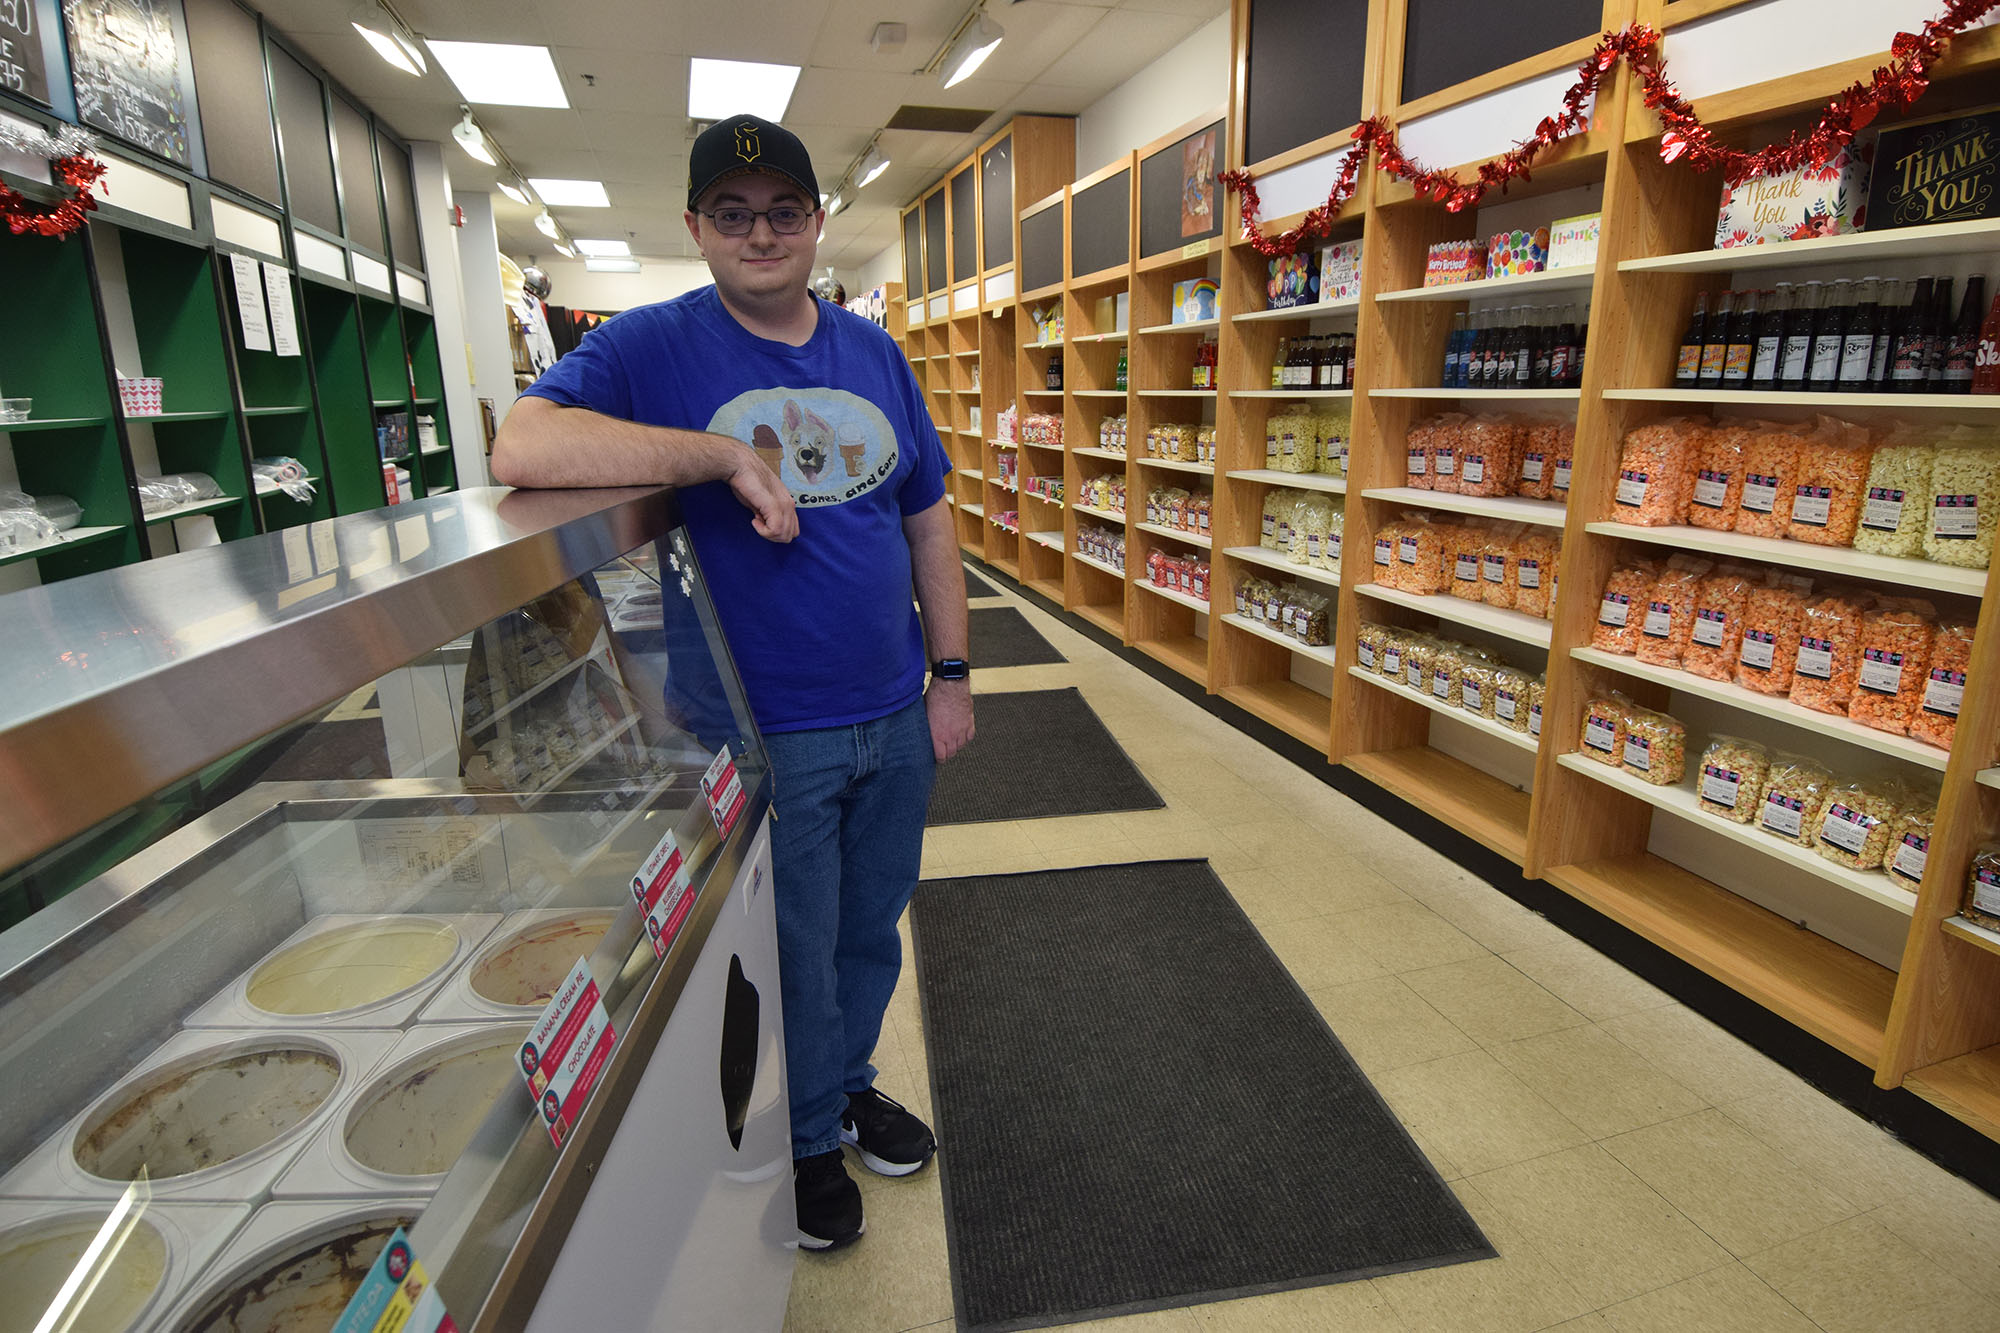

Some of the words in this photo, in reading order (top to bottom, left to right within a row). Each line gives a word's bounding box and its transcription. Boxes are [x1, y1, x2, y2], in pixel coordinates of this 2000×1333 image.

[1744, 169, 1803, 207] Thank
[1895, 133, 1991, 198] THANK
[1752, 203, 1787, 233] You
[1919, 175, 1980, 220] YOU
[1270, 274, 1304, 293] HAPPY
[845, 474, 878, 499] and
[877, 451, 897, 477] Corn
[537, 1008, 561, 1045] BANANA
[560, 983, 578, 1010] CREAM
[576, 971, 585, 986] PIE
[568, 1025, 596, 1073] CHOCOLATE
